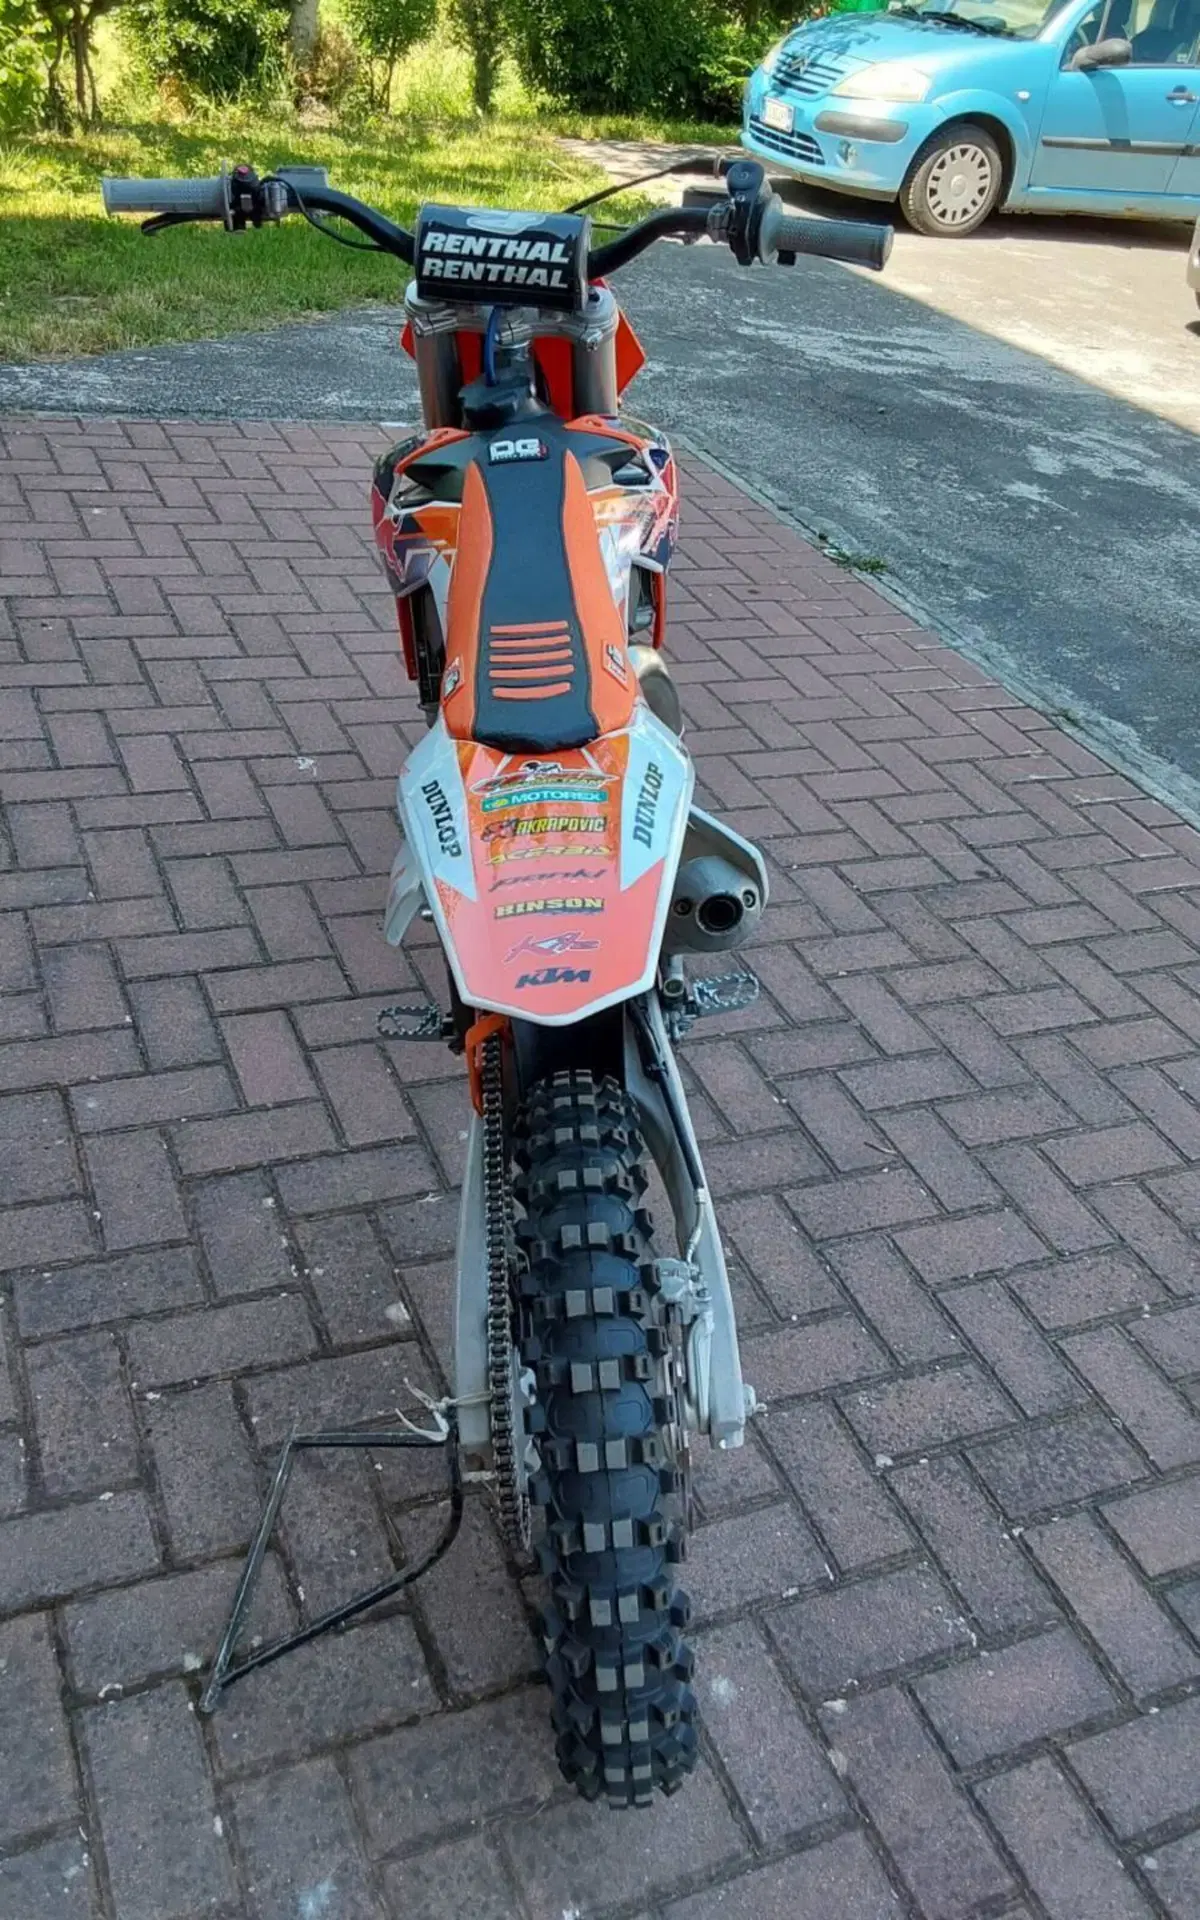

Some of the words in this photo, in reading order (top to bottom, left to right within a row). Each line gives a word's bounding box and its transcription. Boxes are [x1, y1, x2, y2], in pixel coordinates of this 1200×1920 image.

[422, 231, 570, 264] RENTHAL
[422, 257, 568, 288] RENTHAL
[511, 790, 601, 804] MOTOREX
[633, 761, 664, 849] DUNLOP
[421, 779, 462, 857] DUNLOP
[515, 967, 591, 988] KTM
